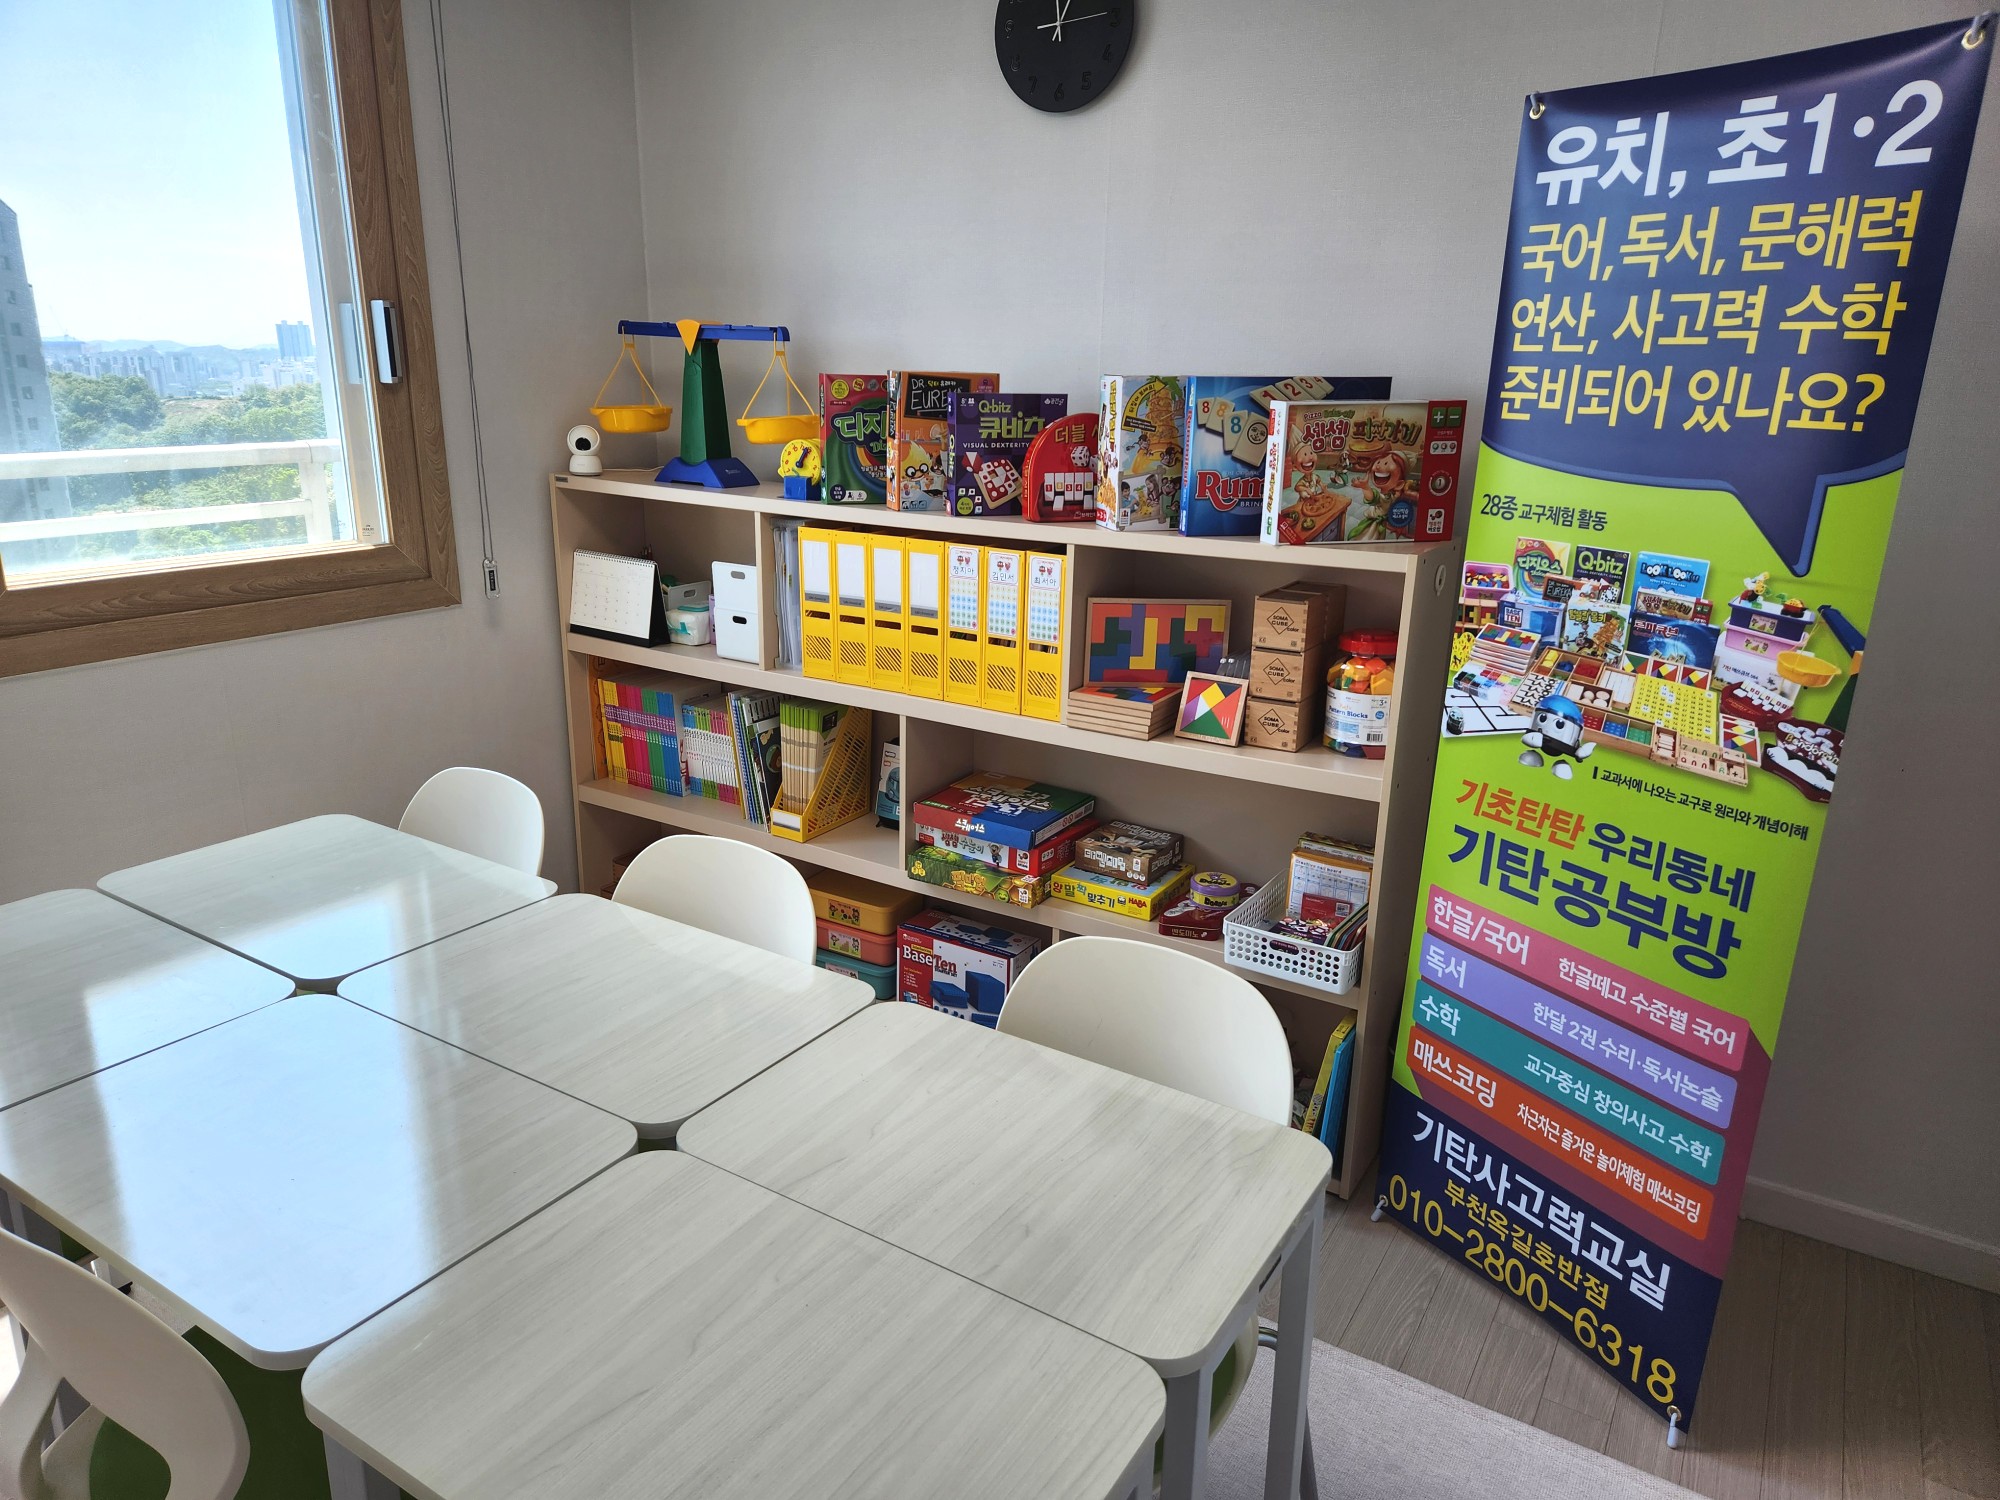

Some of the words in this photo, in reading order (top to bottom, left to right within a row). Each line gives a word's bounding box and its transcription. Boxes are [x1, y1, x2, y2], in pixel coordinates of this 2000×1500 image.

[1028, 76, 1037, 94] 7
[1054, 83, 1064, 100] 6
[1081, 72, 1091, 90] 5
[1535, 111, 1687, 206] 유치,
[1521, 217, 1613, 283] 국어,
[1619, 206, 1726, 278] 독서,
[1738, 189, 1923, 271] 문해력
[1511, 292, 1599, 355] 연산,
[1612, 284, 1768, 355] 사고력
[1778, 281, 1907, 355] 수학
[911, 388, 966, 410] EURE
[1284, 383, 1301, 396] 2
[1300, 378, 1313, 388] 3
[1499, 364, 1672, 429] 준비되어
[1682, 366, 1886, 435] 있나요?
[1055, 423, 1085, 444] 더블
[1202, 401, 1210, 413] 8
[1217, 403, 1228, 417] 8
[1231, 416, 1242, 434] 8
[1480, 493, 1518, 520] 28종
[1519, 503, 1575, 527] 교구체험
[1577, 509, 1608, 531] 활동
[1506, 607, 1521, 615] BASE
[1506, 614, 1521, 623] TEN
[1347, 710, 1368, 719] Blocks
[1600, 769, 1642, 793] 교과서에
[1644, 782, 1677, 803] 나오는
[1677, 792, 1712, 813] 교구로
[1714, 803, 1751, 825] 원리와
[1752, 814, 1809, 840] 개념이해
[955, 818, 985, 833] 스퀘어스
[1455, 779, 1585, 850] 기초탄탄
[1587, 821, 1756, 912] 우리동네
[1087, 892, 1115, 908] 맞추기
[1128, 897, 1147, 908] HABA
[1448, 823, 1741, 979] 기탄공부방
[902, 944, 932, 965] Base
[933, 954, 957, 973] Ten
[1433, 895, 1530, 964] 한글/국어
[1558, 957, 1627, 1006] 한글떼고
[1629, 991, 1688, 1036] 수준별
[1691, 1017, 1737, 1054] 국어
[1425, 945, 1467, 989] 독서
[1532, 1001, 1567, 1034] 한달
[1568, 1021, 1598, 1050] 2권
[1418, 995, 1461, 1037] 수학
[1524, 1053, 1591, 1103] 교구중심
[1593, 1089, 1665, 1145] 창의사고
[1668, 1131, 1713, 1168] 수학
[1412, 1038, 1497, 1109] 매쓰코딩
[1517, 1103, 1560, 1142] 차근차근
[1561, 1129, 1596, 1164] 즐거운
[1596, 1148, 1646, 1192] 놀이체험
[1646, 1179, 1701, 1224] 매쓰코딩
[1413, 1111, 1671, 1311] 기탄사고력교실
[1444, 1179, 1610, 1310] 부천옥길호반점
[1388, 1174, 1677, 1404] 010-2800-6318
